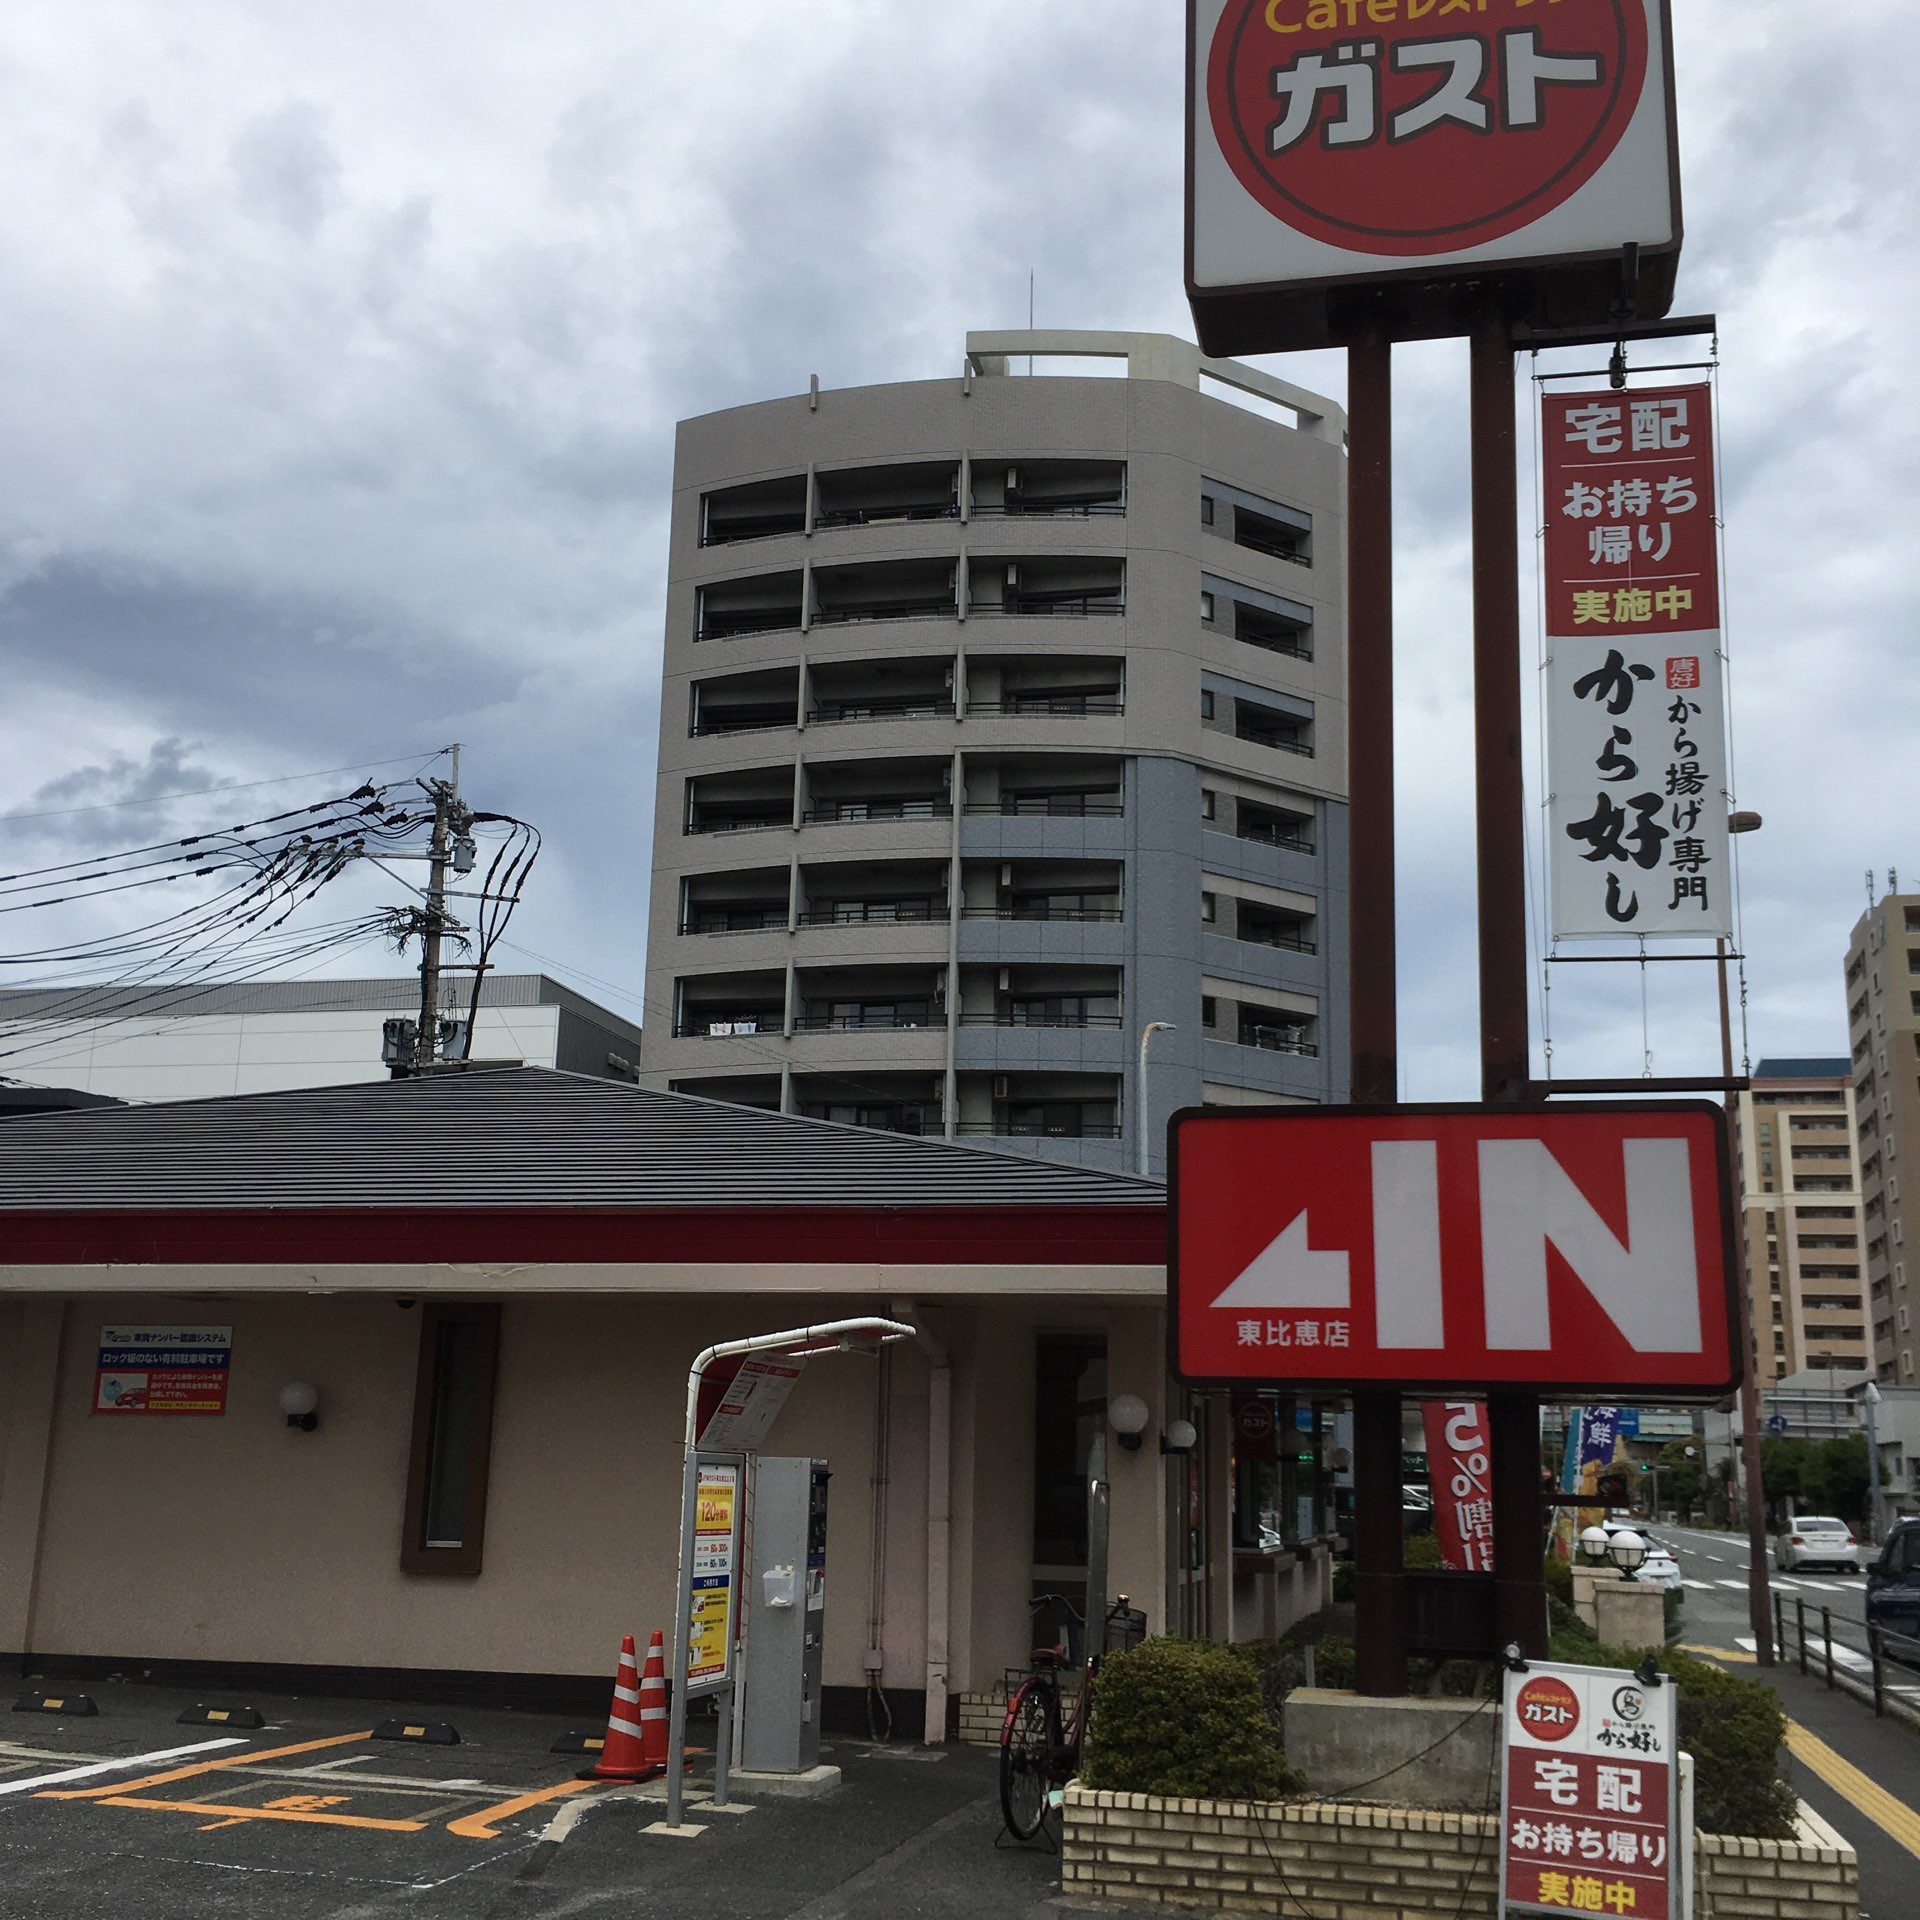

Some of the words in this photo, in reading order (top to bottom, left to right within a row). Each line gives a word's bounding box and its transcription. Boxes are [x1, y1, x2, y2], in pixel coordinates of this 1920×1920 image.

[1271, 31, 1600, 153] ガスト
[1565, 398, 1690, 453] 宅配
[1562, 475, 1697, 519] お持ち
[1588, 522, 1671, 564] 帰り
[1572, 585, 1692, 624] 実施中
[1566, 649, 1670, 922] から好し
[1665, 695, 1712, 911] から揚げ専門
[1209, 1138, 1702, 1353] AIN
[1237, 1319, 1350, 1347] 東比恵店
[1525, 1704, 1574, 1725] ガスト
[1597, 1728, 1662, 1753] から好し
[1534, 1759, 1643, 1814] 宅配
[1511, 1819, 1667, 1868] お持ち帰り
[1538, 1872, 1636, 1914] 実施中
